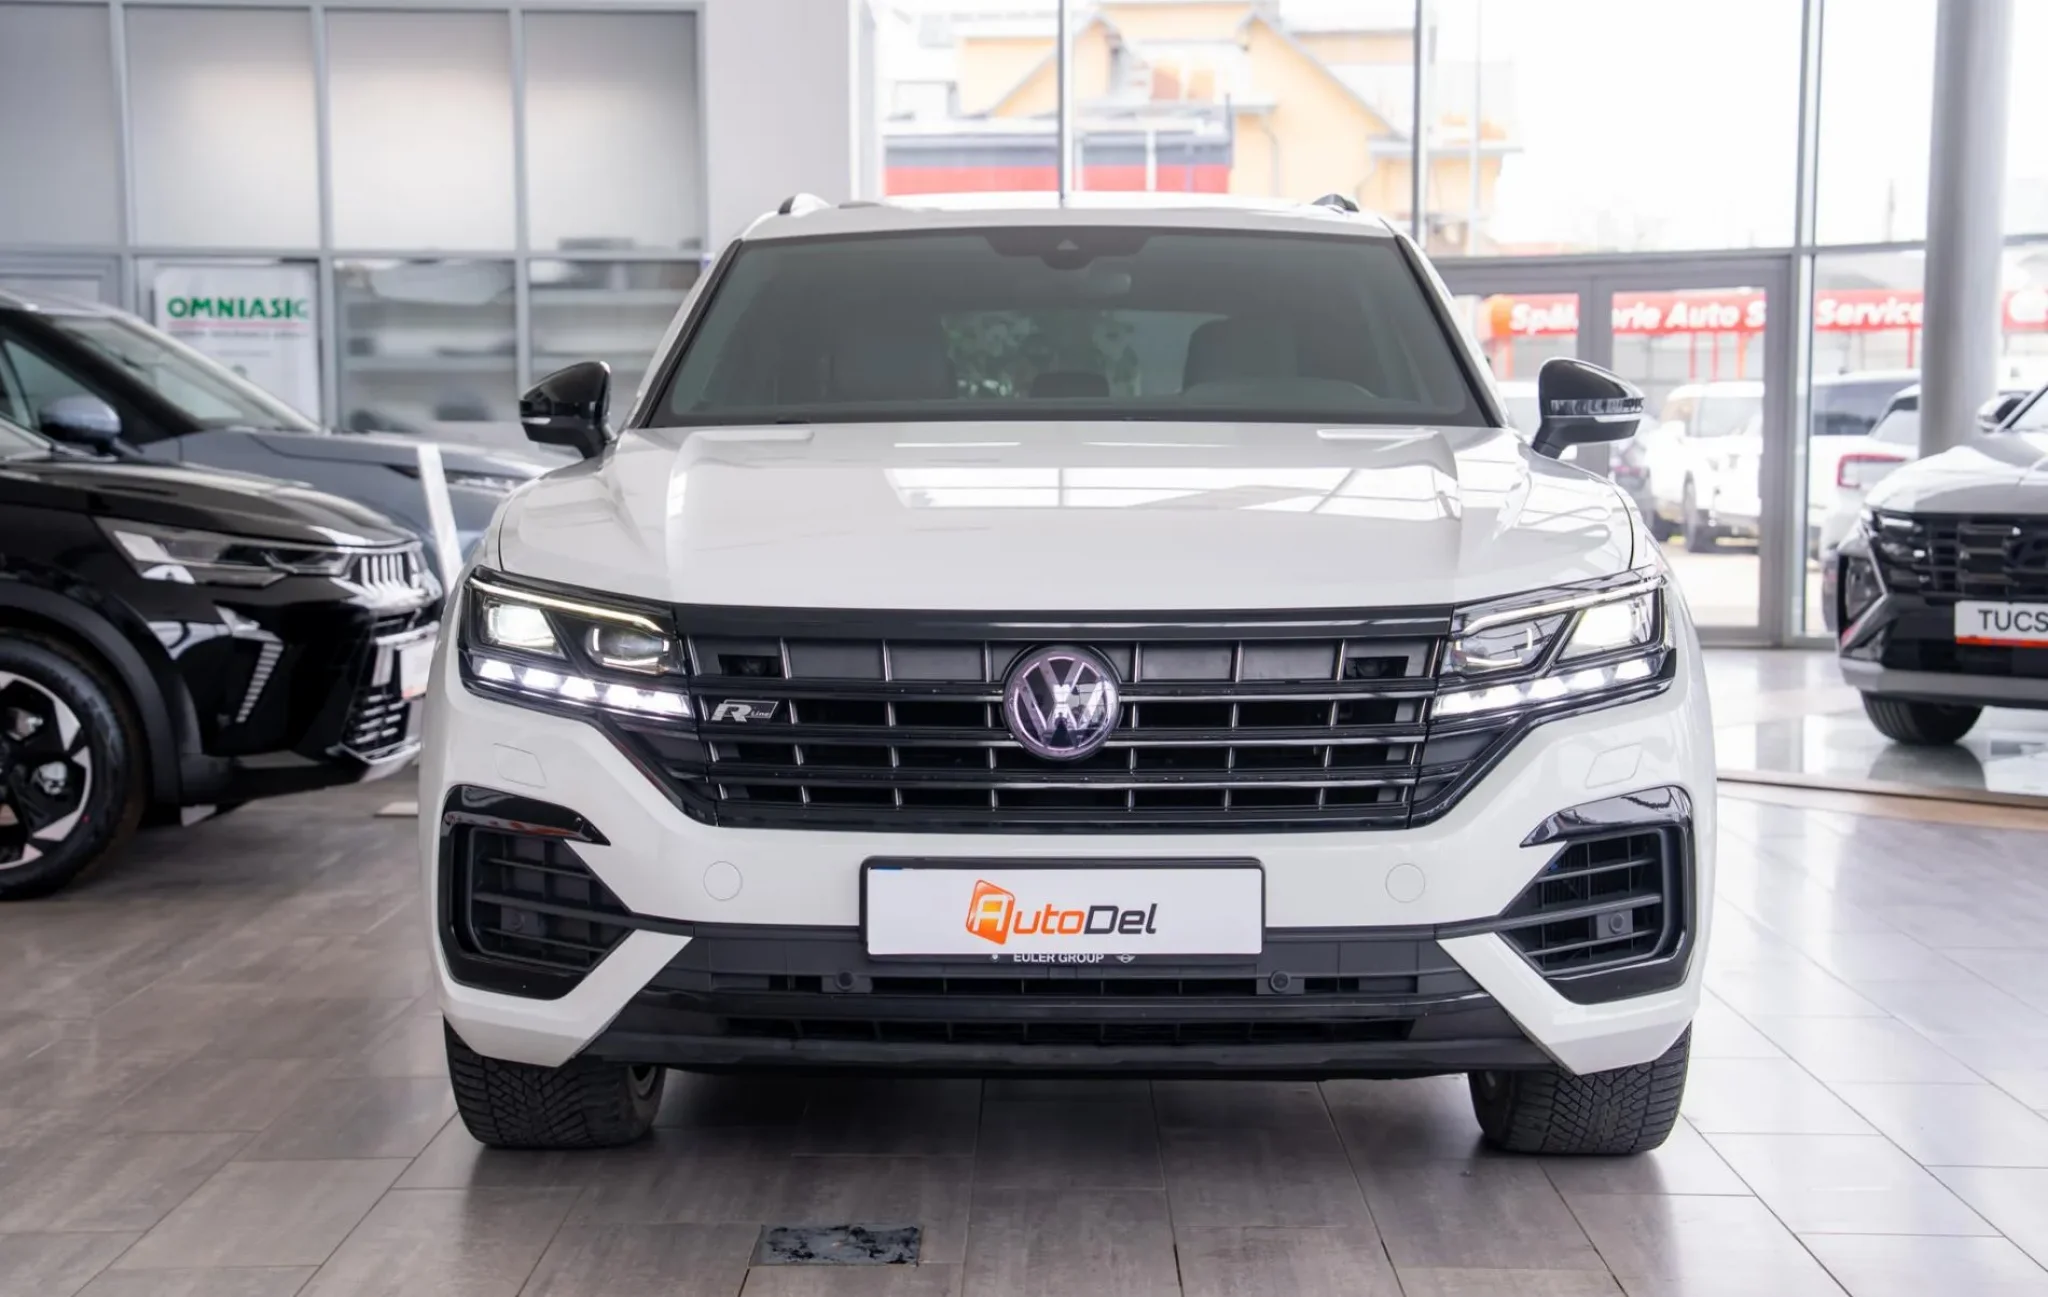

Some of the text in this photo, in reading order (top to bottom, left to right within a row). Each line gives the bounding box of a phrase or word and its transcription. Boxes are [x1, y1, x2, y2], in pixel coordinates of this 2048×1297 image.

[1664, 301, 1741, 329] Auto
[711, 703, 752, 723] R
[967, 882, 1158, 943] AutoDel
[1013, 953, 1105, 963] EULER GROUP
